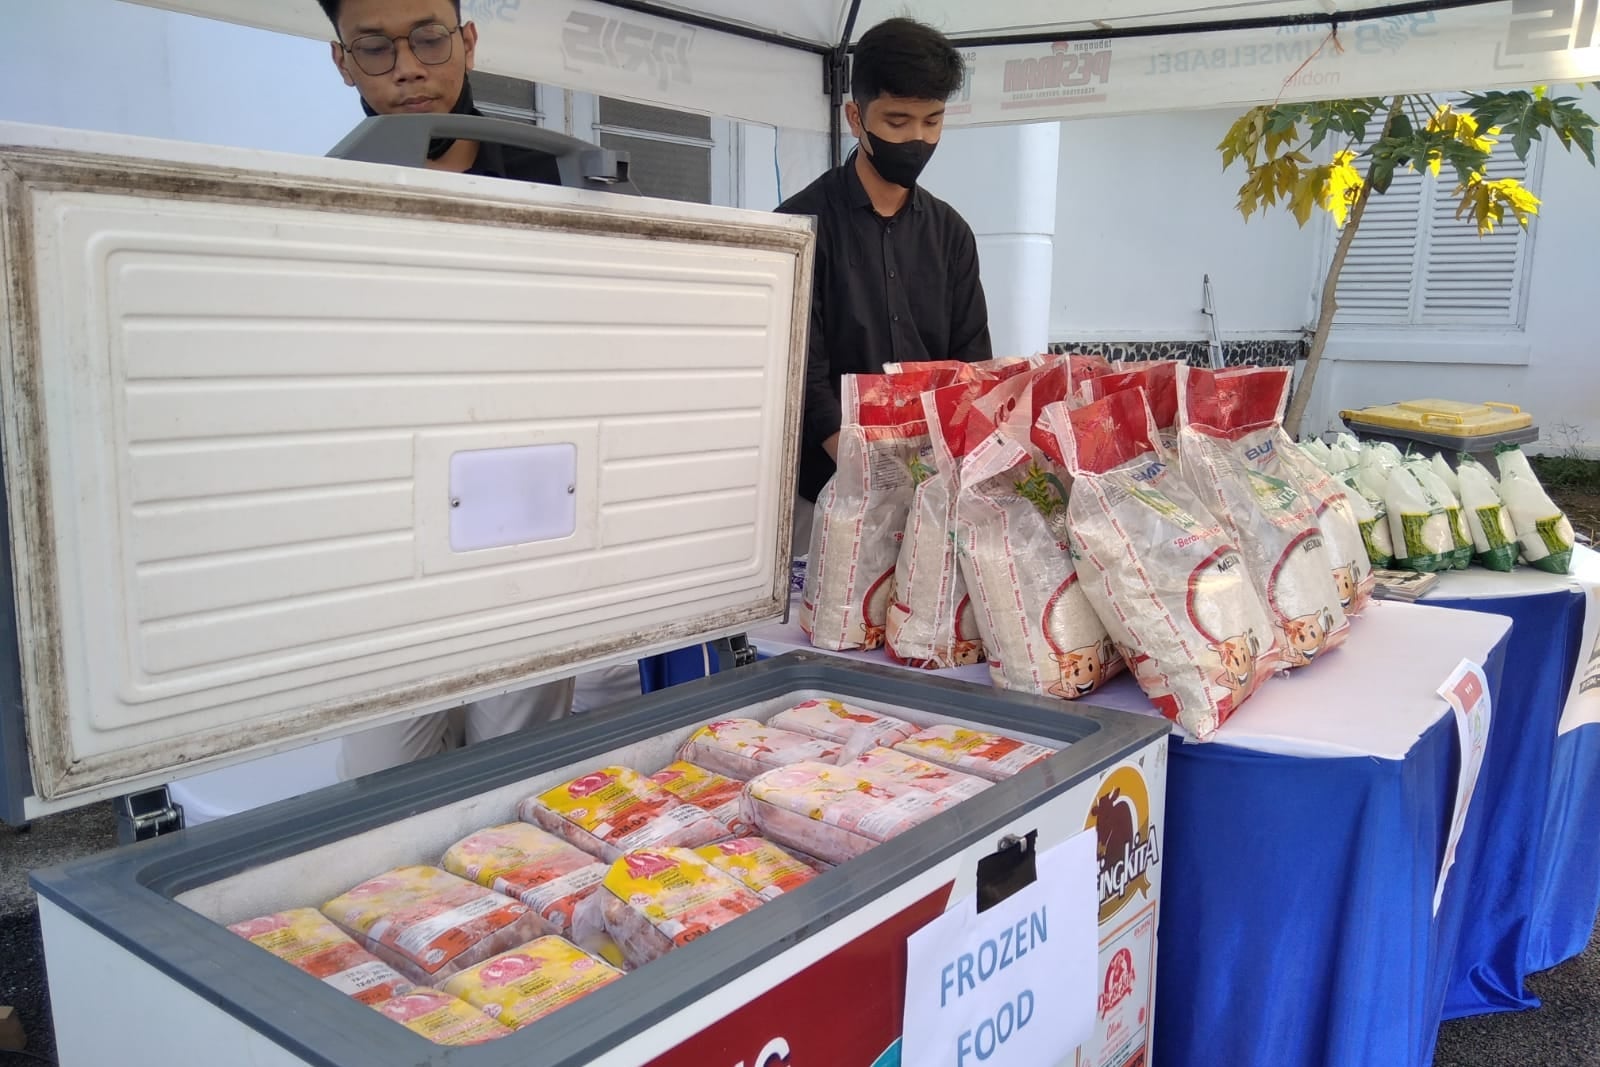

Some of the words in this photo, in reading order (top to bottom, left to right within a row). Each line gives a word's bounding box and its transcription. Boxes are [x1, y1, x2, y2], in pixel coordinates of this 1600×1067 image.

[610, 815, 647, 838] CM-01
[939, 904, 1048, 1009] FROZEN
[956, 989, 1035, 1067] FOOD
